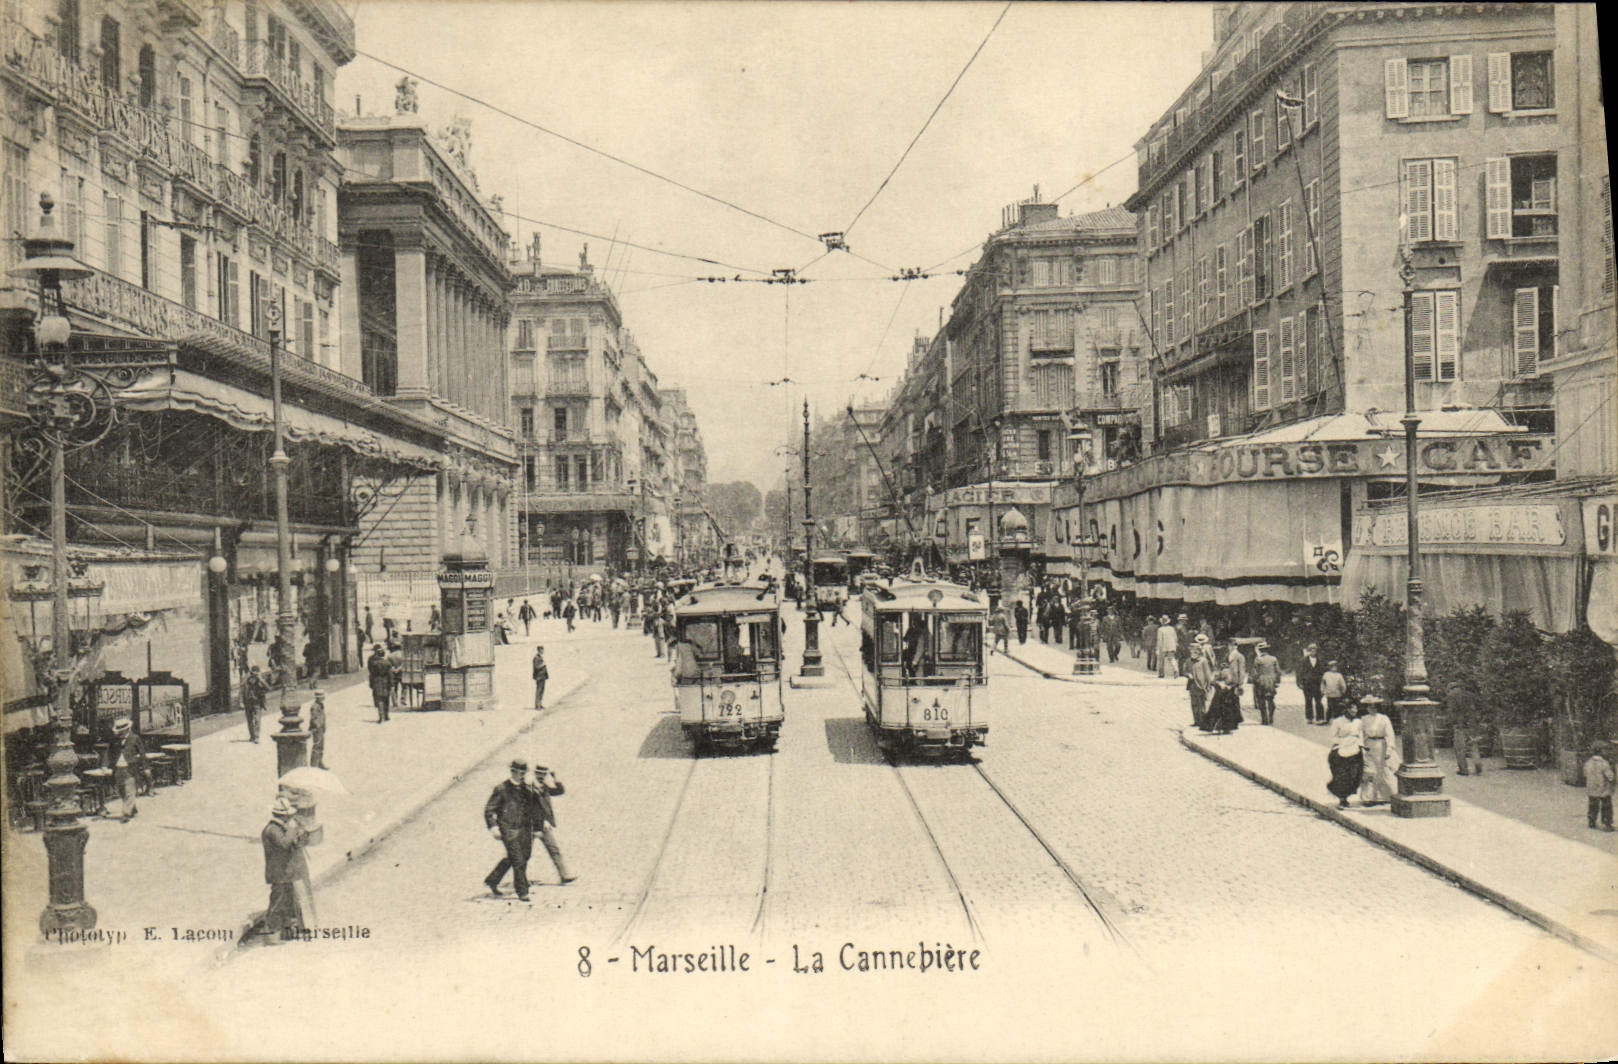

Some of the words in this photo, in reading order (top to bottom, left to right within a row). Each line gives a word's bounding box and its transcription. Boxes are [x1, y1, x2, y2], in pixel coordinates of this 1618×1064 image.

[1421, 438, 1556, 471] CAF
[1489, 507, 1545, 542] BAR
[718, 703, 742, 717] 722
[923, 707, 948, 721] 810
